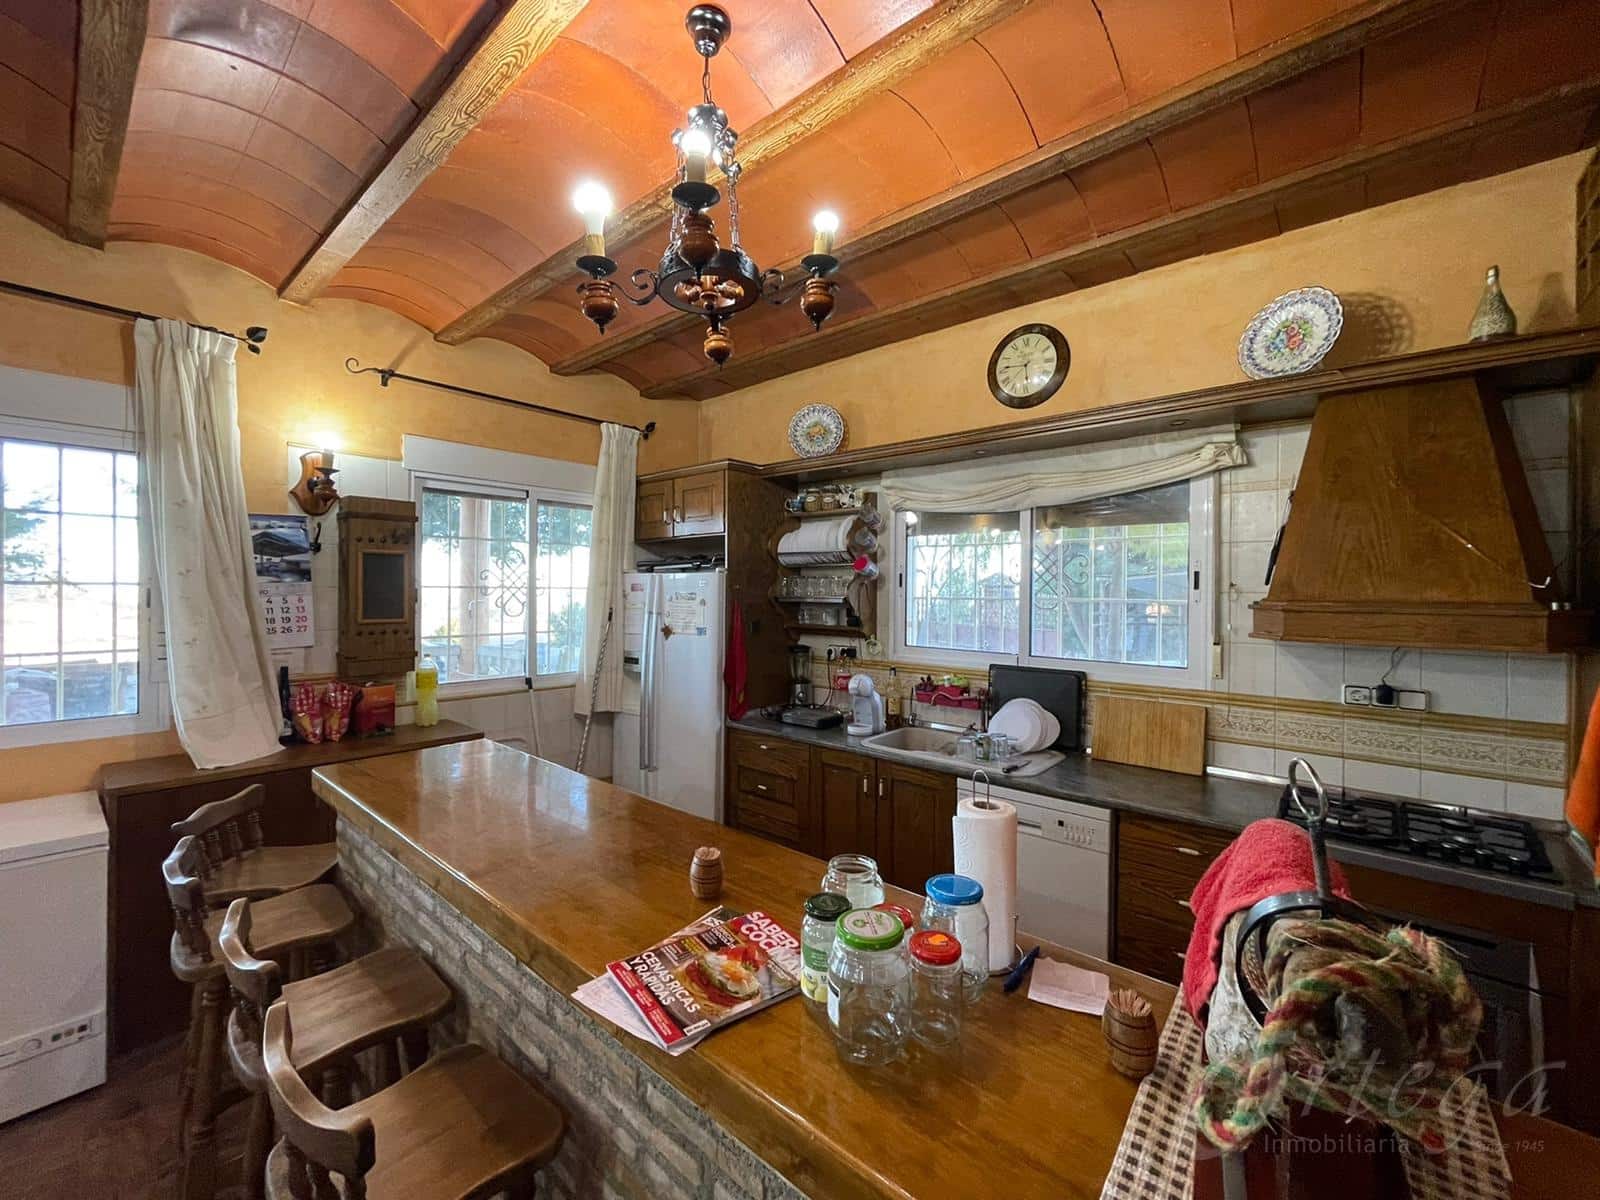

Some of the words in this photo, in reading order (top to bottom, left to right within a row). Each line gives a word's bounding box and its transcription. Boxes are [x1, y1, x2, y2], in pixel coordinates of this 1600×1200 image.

[282, 597, 288, 605] 5
[297, 596, 304, 604] 6
[265, 607, 274, 615] 11
[280, 606, 290, 614] 12
[265, 617, 276, 625] 18
[295, 615, 308, 623] 20
[280, 626, 293, 634] 26
[296, 625, 308, 633] 27
[746, 911, 800, 949] SABER
[630, 956, 644, 965] Y
[641, 951, 674, 982] CENAS
[666, 980, 701, 1013] RICAS
